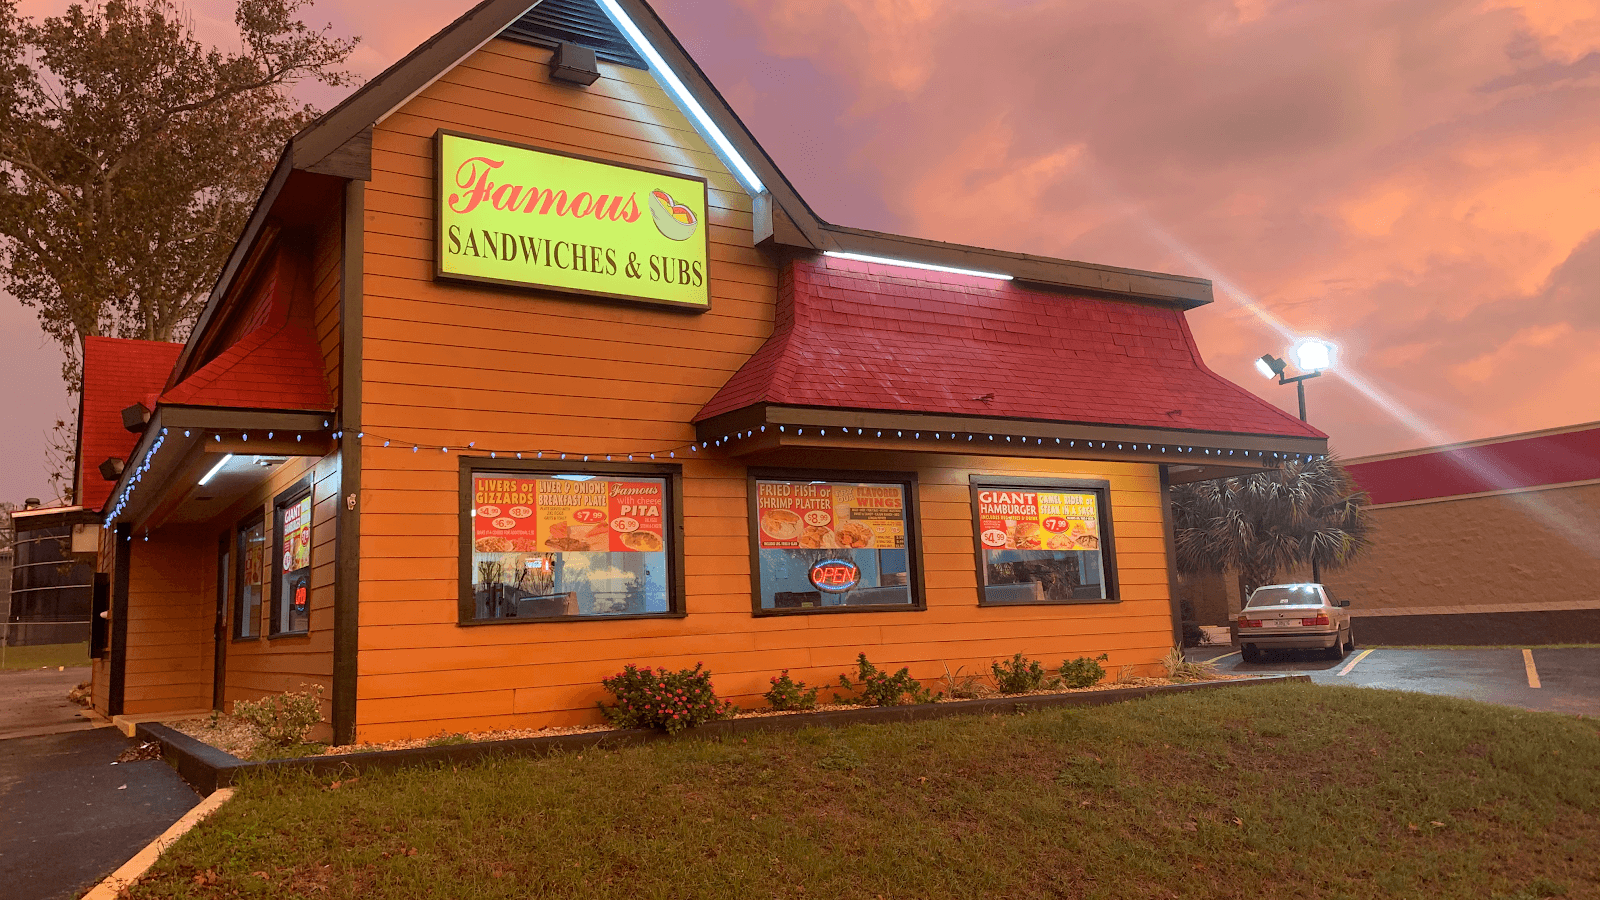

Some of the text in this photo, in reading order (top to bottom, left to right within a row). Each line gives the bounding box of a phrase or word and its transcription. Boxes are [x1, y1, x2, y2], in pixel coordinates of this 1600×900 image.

[448, 156, 642, 224] Famous
[448, 224, 703, 288] SANDWICHES & SUBS
[478, 479, 534, 492] LIVERS or
[539, 481, 606, 494] LIVER & ONIONS
[609, 483, 658, 497] Famous
[760, 484, 831, 498] FRIED FISH or
[856, 487, 899, 497] FLAVORED
[476, 492, 534, 505] GIZZARDS
[538, 494, 607, 507] BREAKFAST PLATE
[617, 496, 635, 504] with
[759, 497, 831, 510] SHRIMP PLATTER
[857, 497, 902, 508] WINGS
[979, 491, 1036, 504] GIANT
[620, 504, 659, 517] PITA
[980, 503, 1037, 515] HAMBURGER
[577, 511, 603, 521] $7.99
[807, 513, 829, 524] $8.99
[614, 520, 636, 530] $6.99
[1045, 519, 1067, 530] $7.99
[984, 532, 1005, 543] $4.99
[812, 567, 857, 583] OPEN
